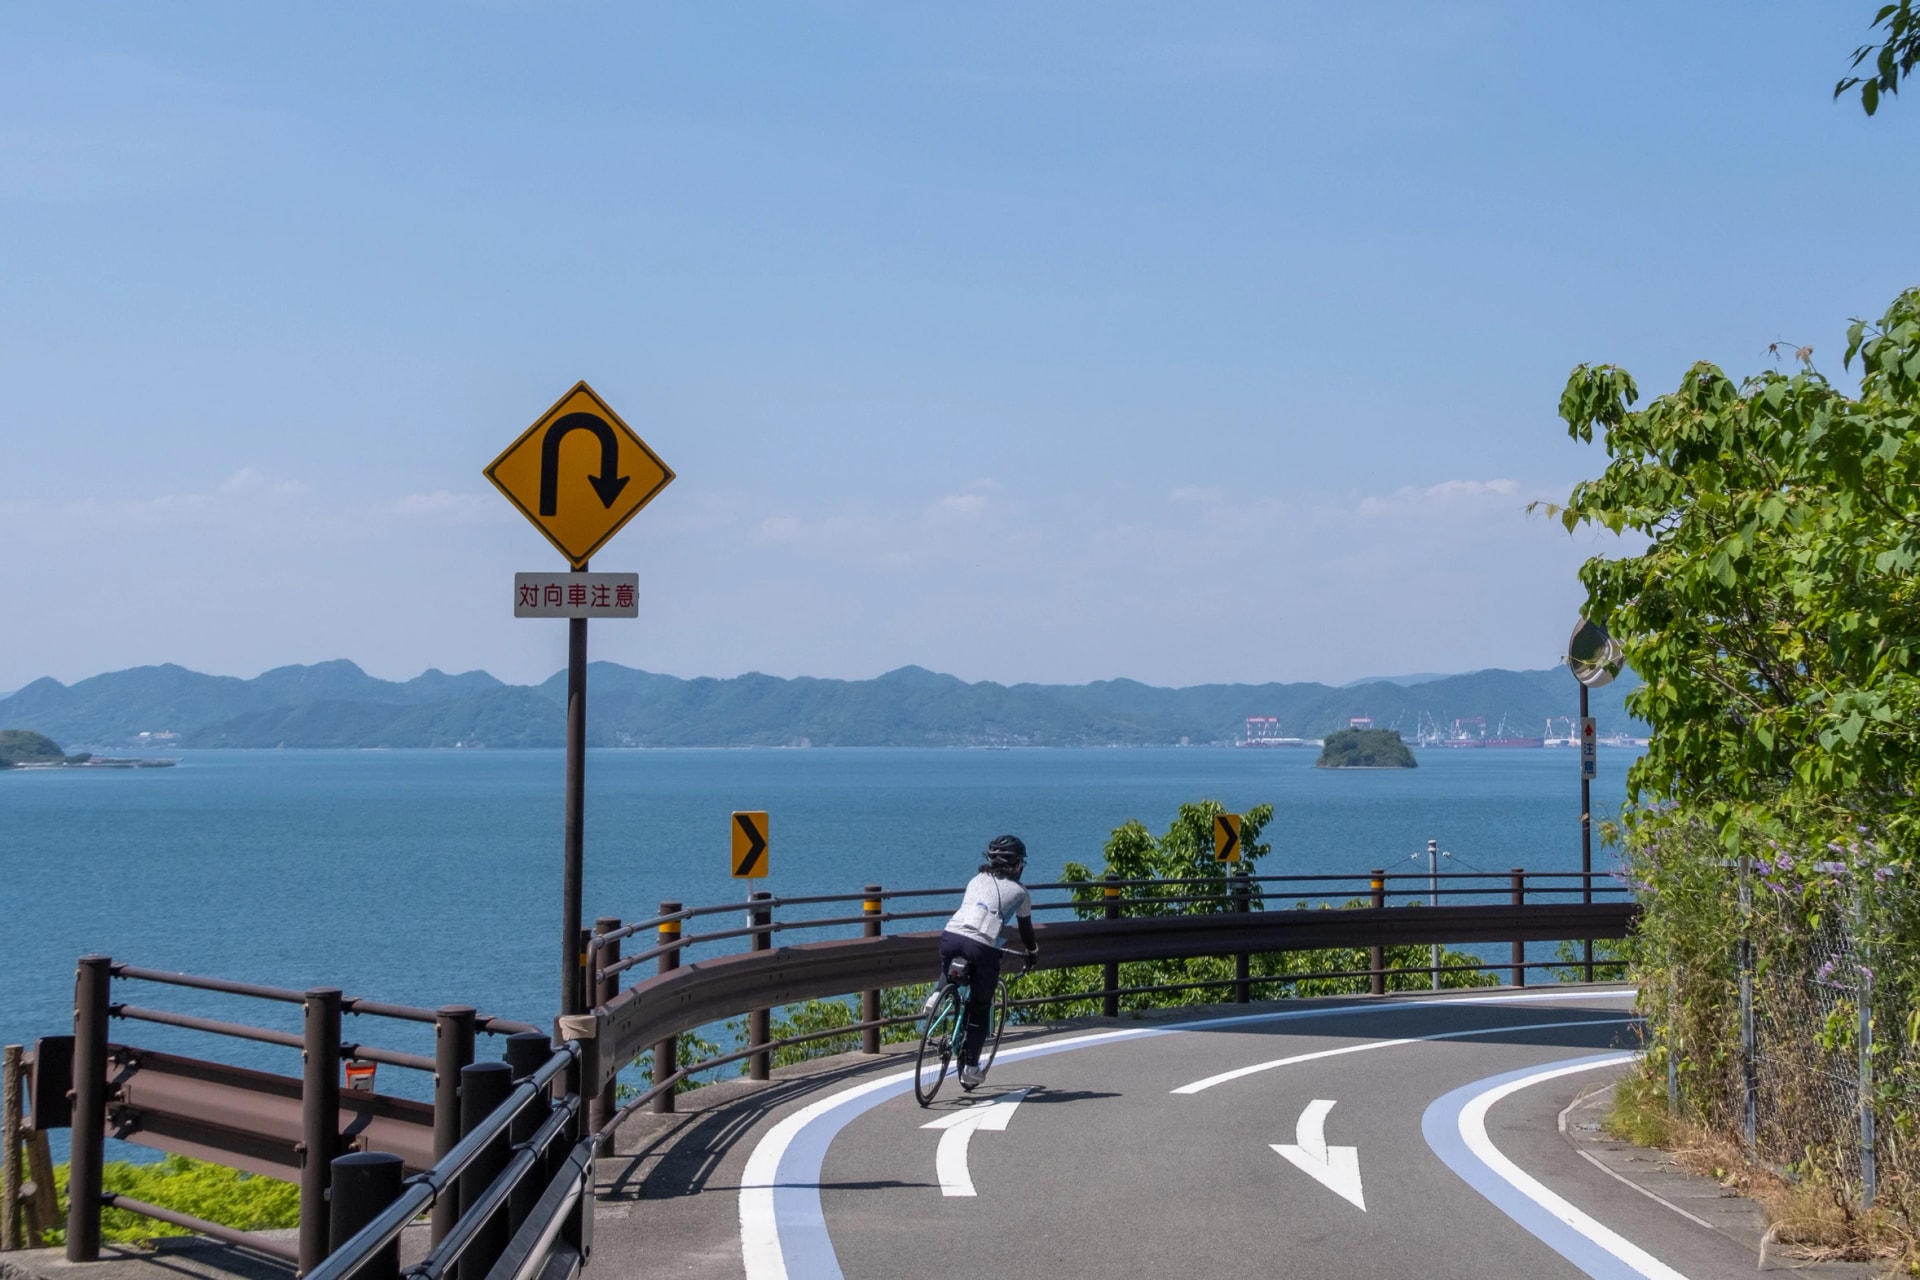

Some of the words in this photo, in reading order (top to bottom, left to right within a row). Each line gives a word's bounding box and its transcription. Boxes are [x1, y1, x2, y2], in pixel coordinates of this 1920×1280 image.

[519, 583, 635, 608] 対向車注意
